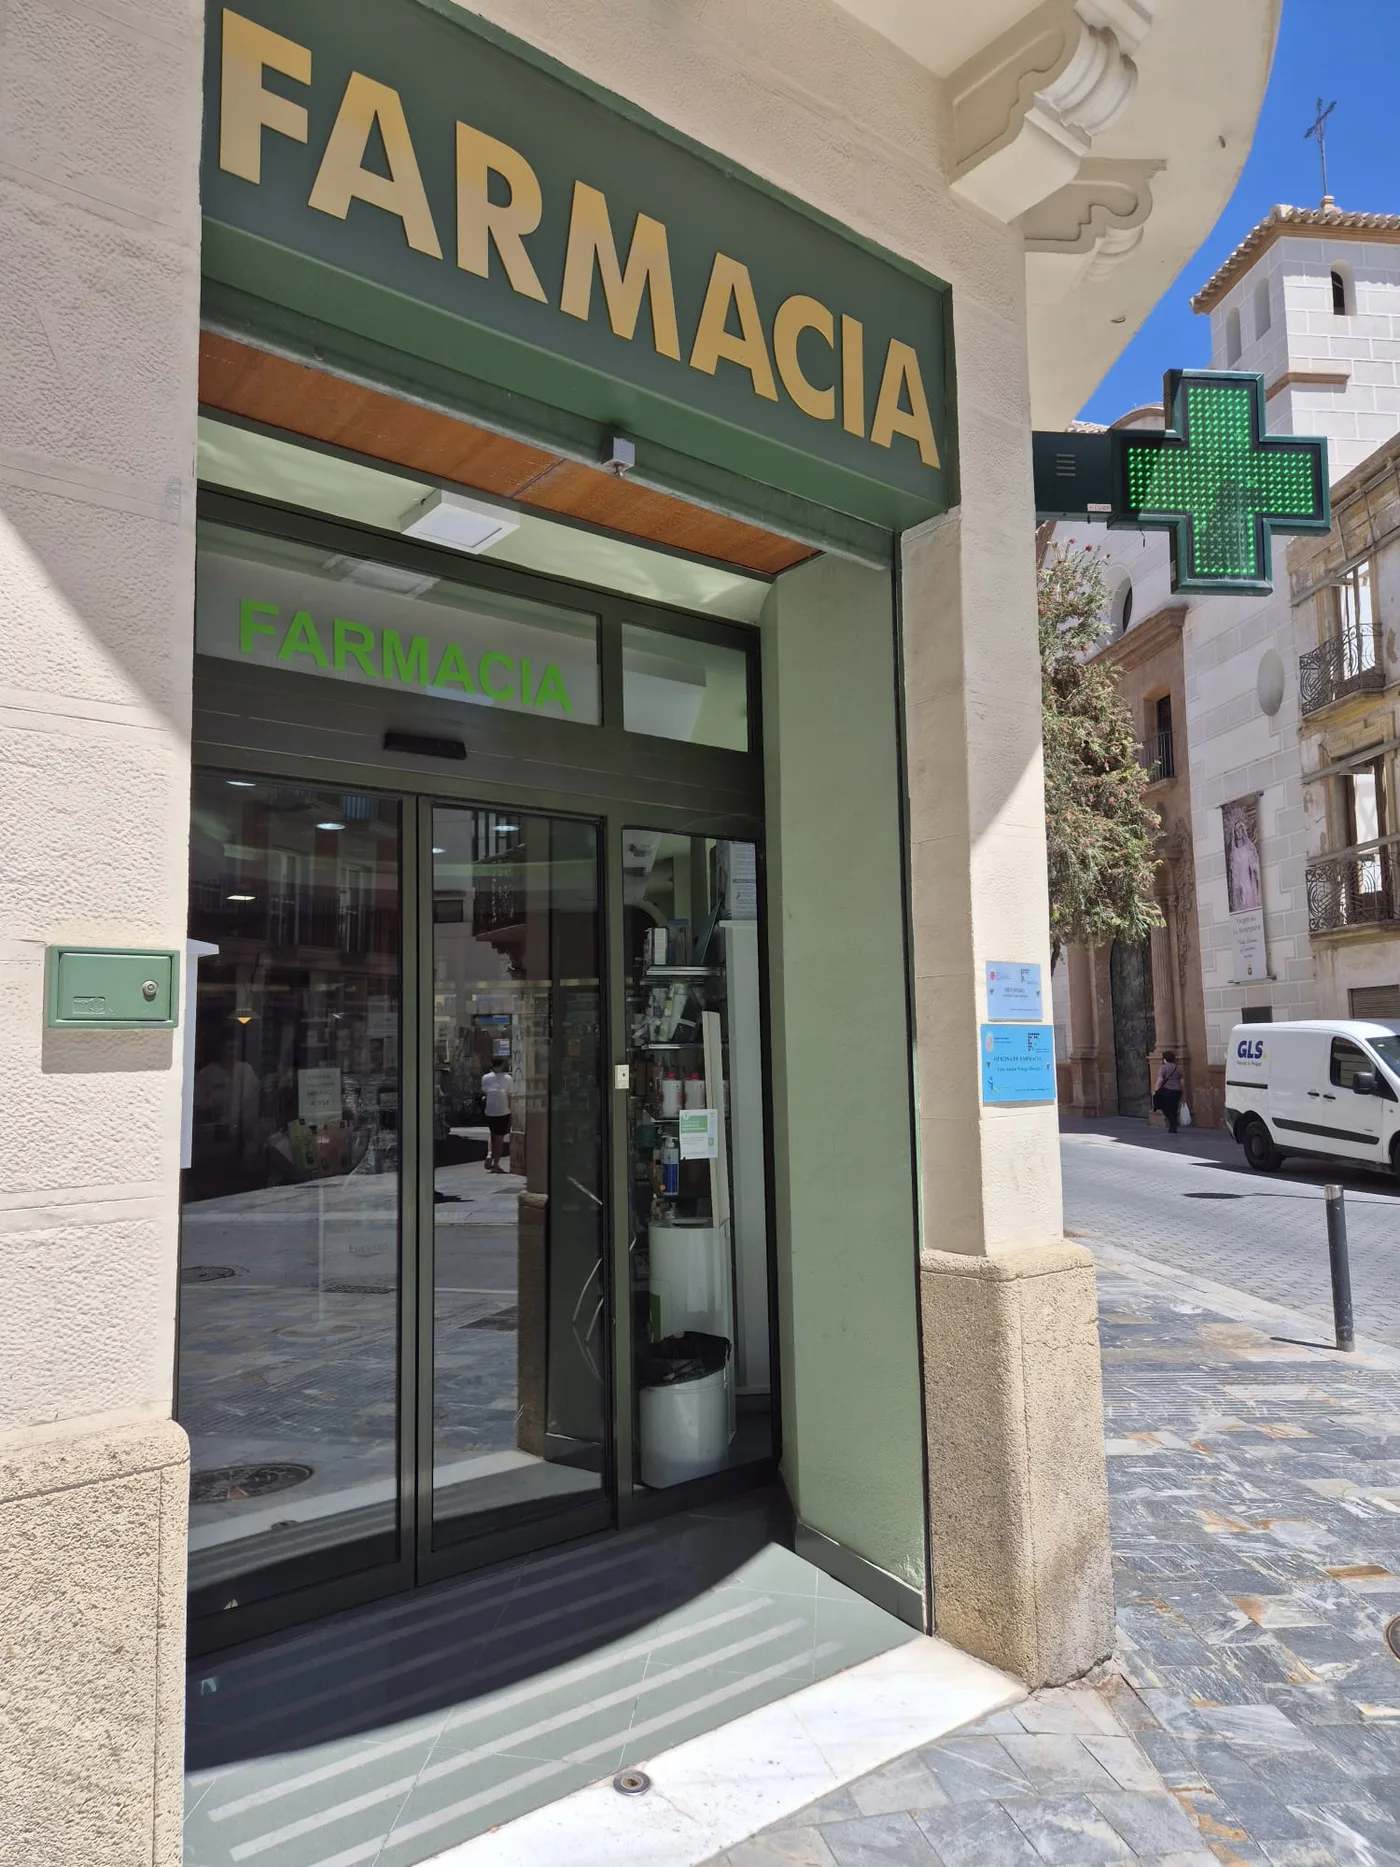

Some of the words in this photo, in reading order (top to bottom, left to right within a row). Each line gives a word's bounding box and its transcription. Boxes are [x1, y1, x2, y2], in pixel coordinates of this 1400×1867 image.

[220, 7, 941, 470] FARMACIA
[239, 599, 573, 714] FARMACIA
[1237, 1040, 1264, 1059] GLS
